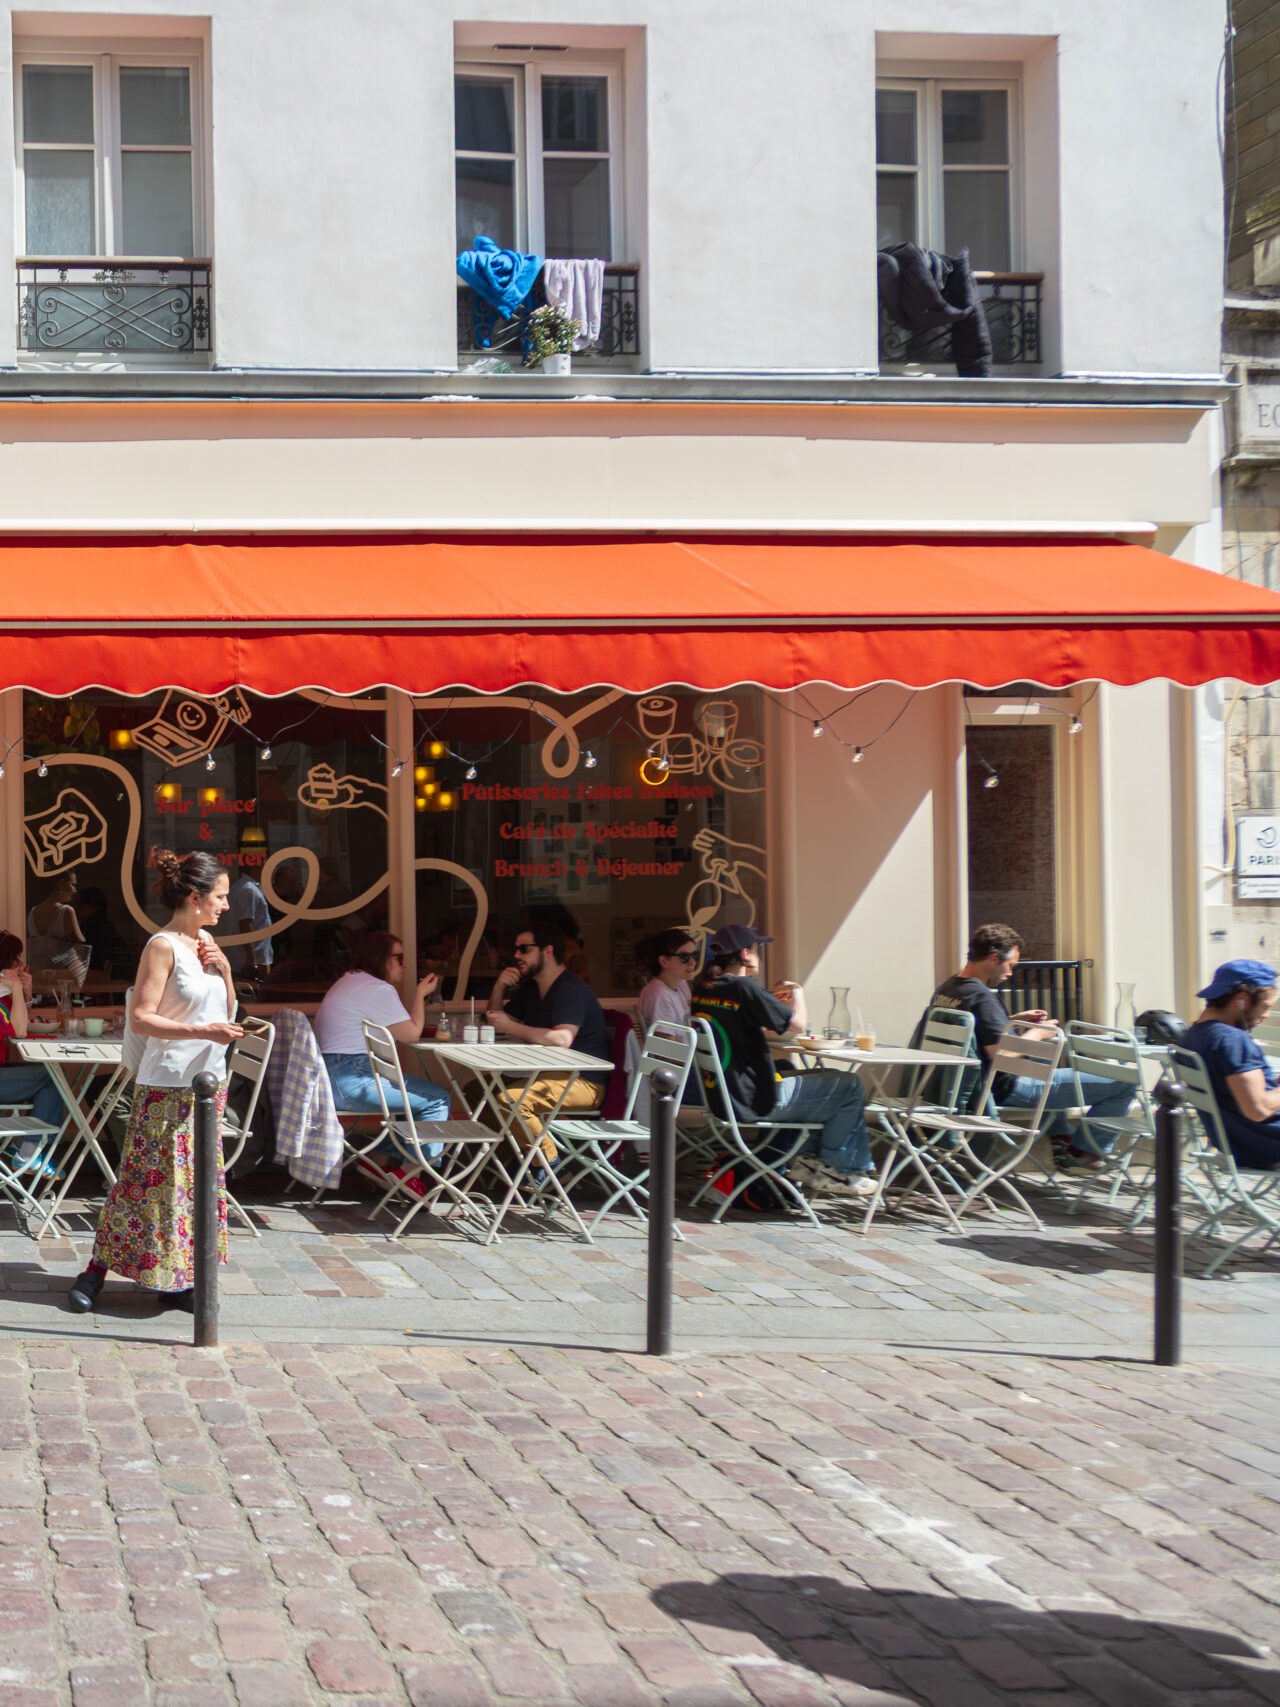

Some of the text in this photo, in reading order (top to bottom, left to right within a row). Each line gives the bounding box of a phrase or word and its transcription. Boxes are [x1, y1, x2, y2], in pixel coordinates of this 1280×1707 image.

[462, 782, 715, 801] Pâtisseries faites maison
[155, 796, 257, 817] Sur place
[198, 823, 214, 840] &
[499, 820, 679, 844] Café de Spécialité
[494, 857, 685, 881] Brunch & Déjeuner
